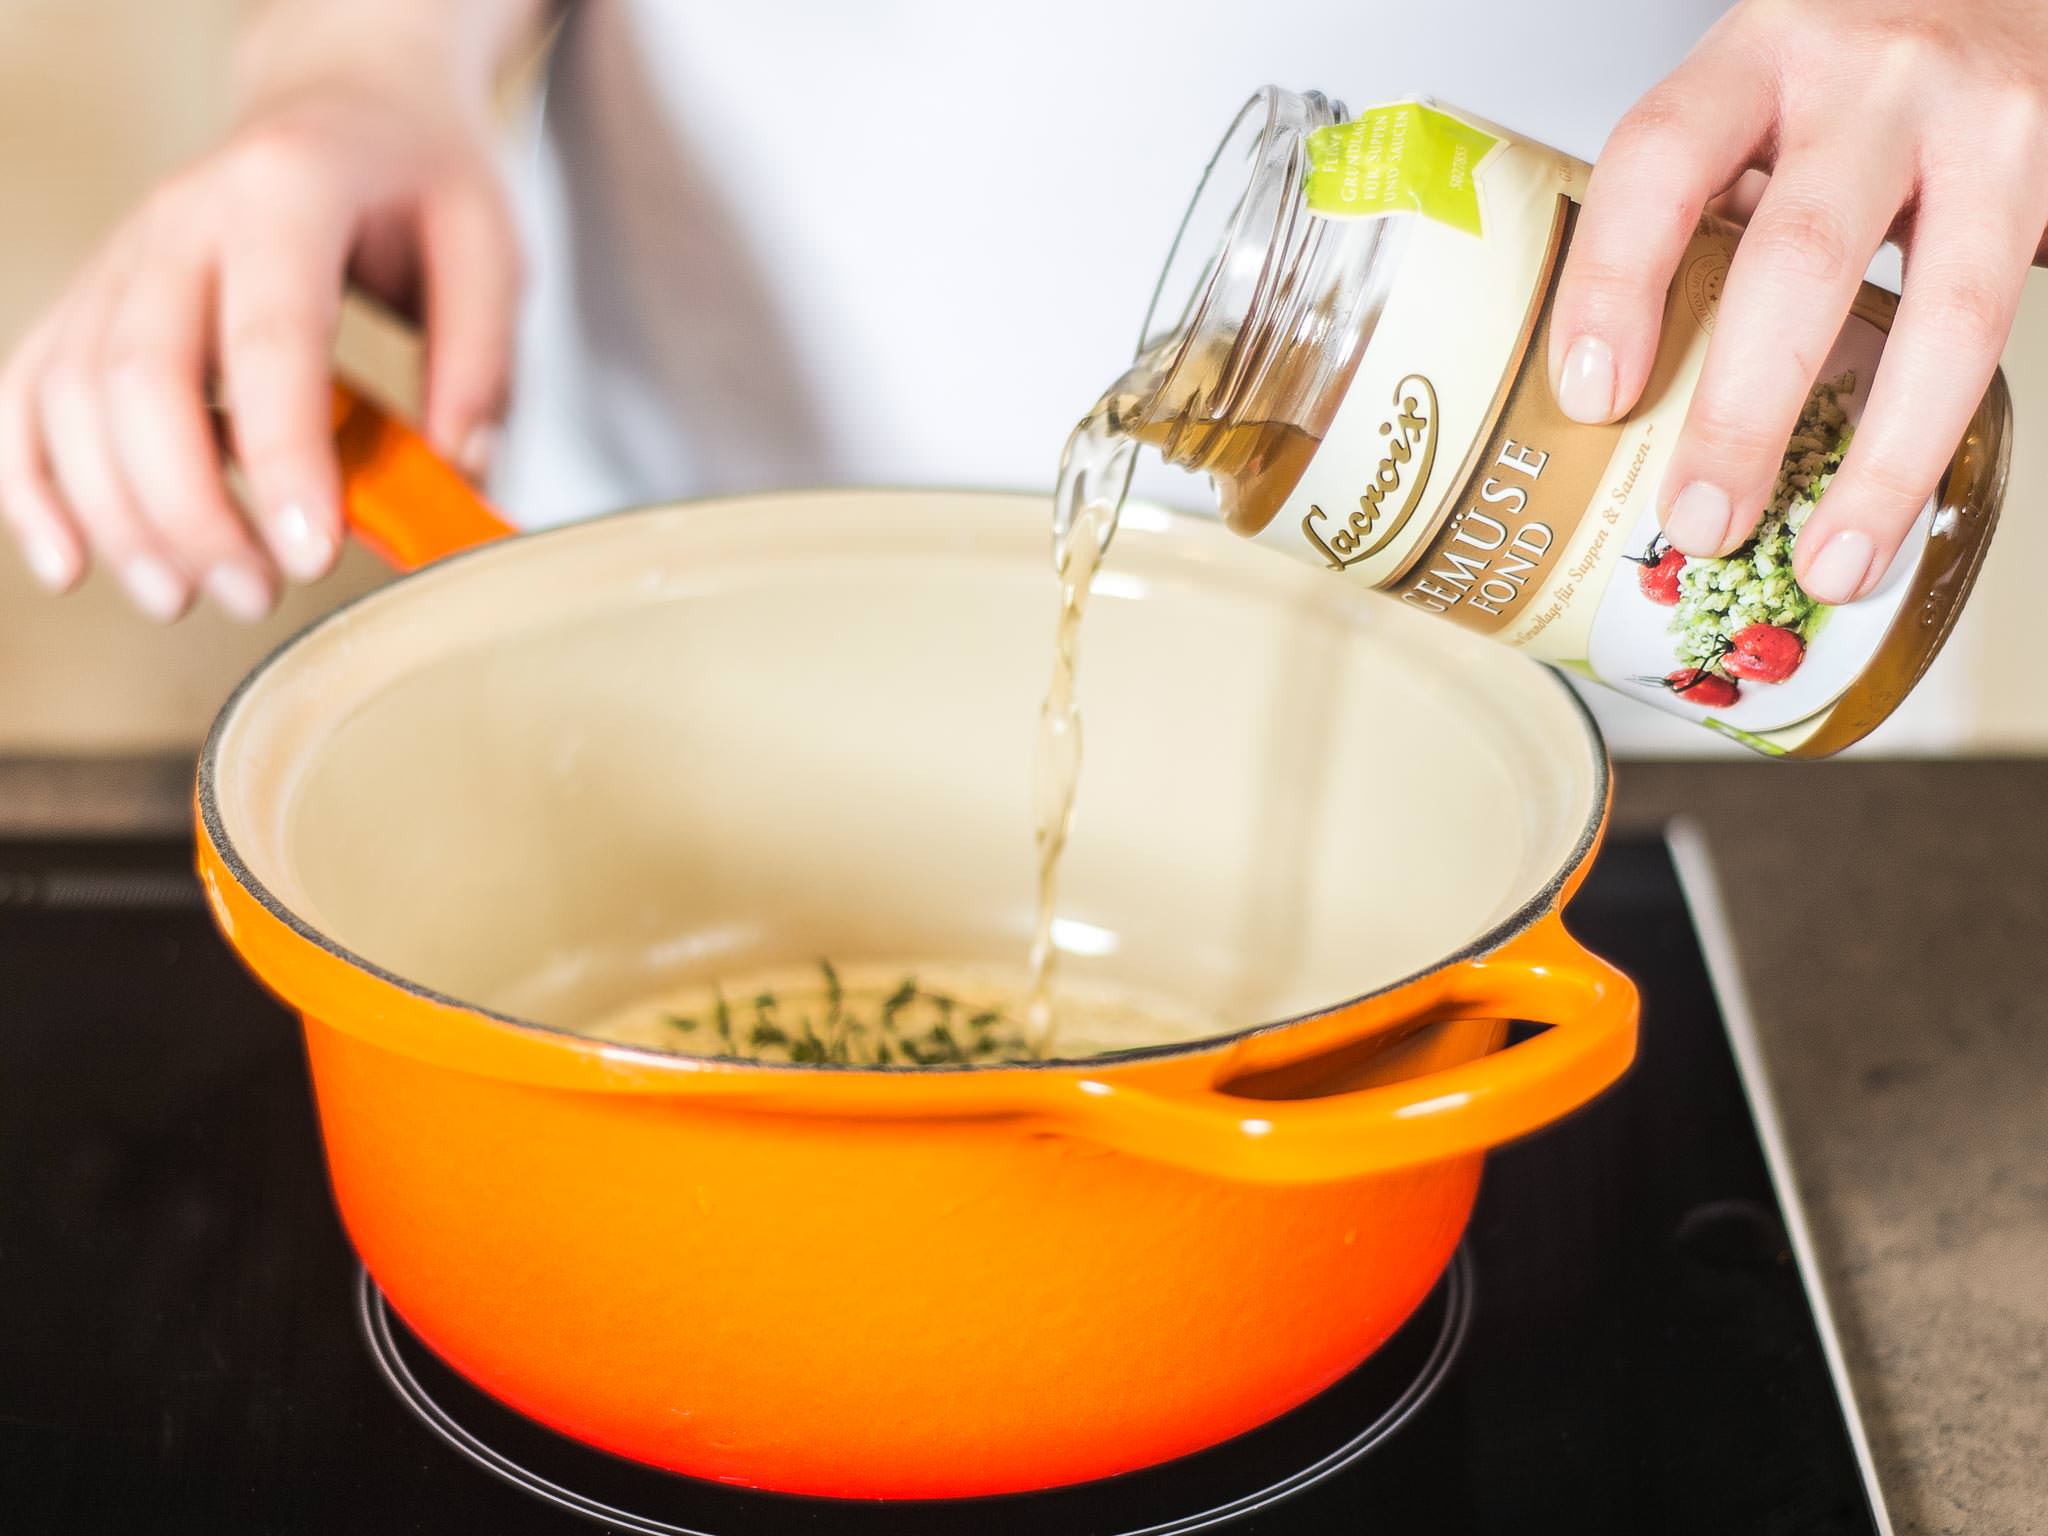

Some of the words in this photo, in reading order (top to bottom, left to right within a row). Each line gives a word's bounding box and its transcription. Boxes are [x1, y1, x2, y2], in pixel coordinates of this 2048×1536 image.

[1302, 374, 1439, 571] Lacroix
[1401, 440, 1550, 614] GEMÜSE
[1554, 583, 1576, 608] für
[1567, 528, 1609, 584] Suppen
[1602, 507, 1620, 525] &
[1611, 442, 1651, 505] Saucen
[1467, 522, 1554, 616] FOND
